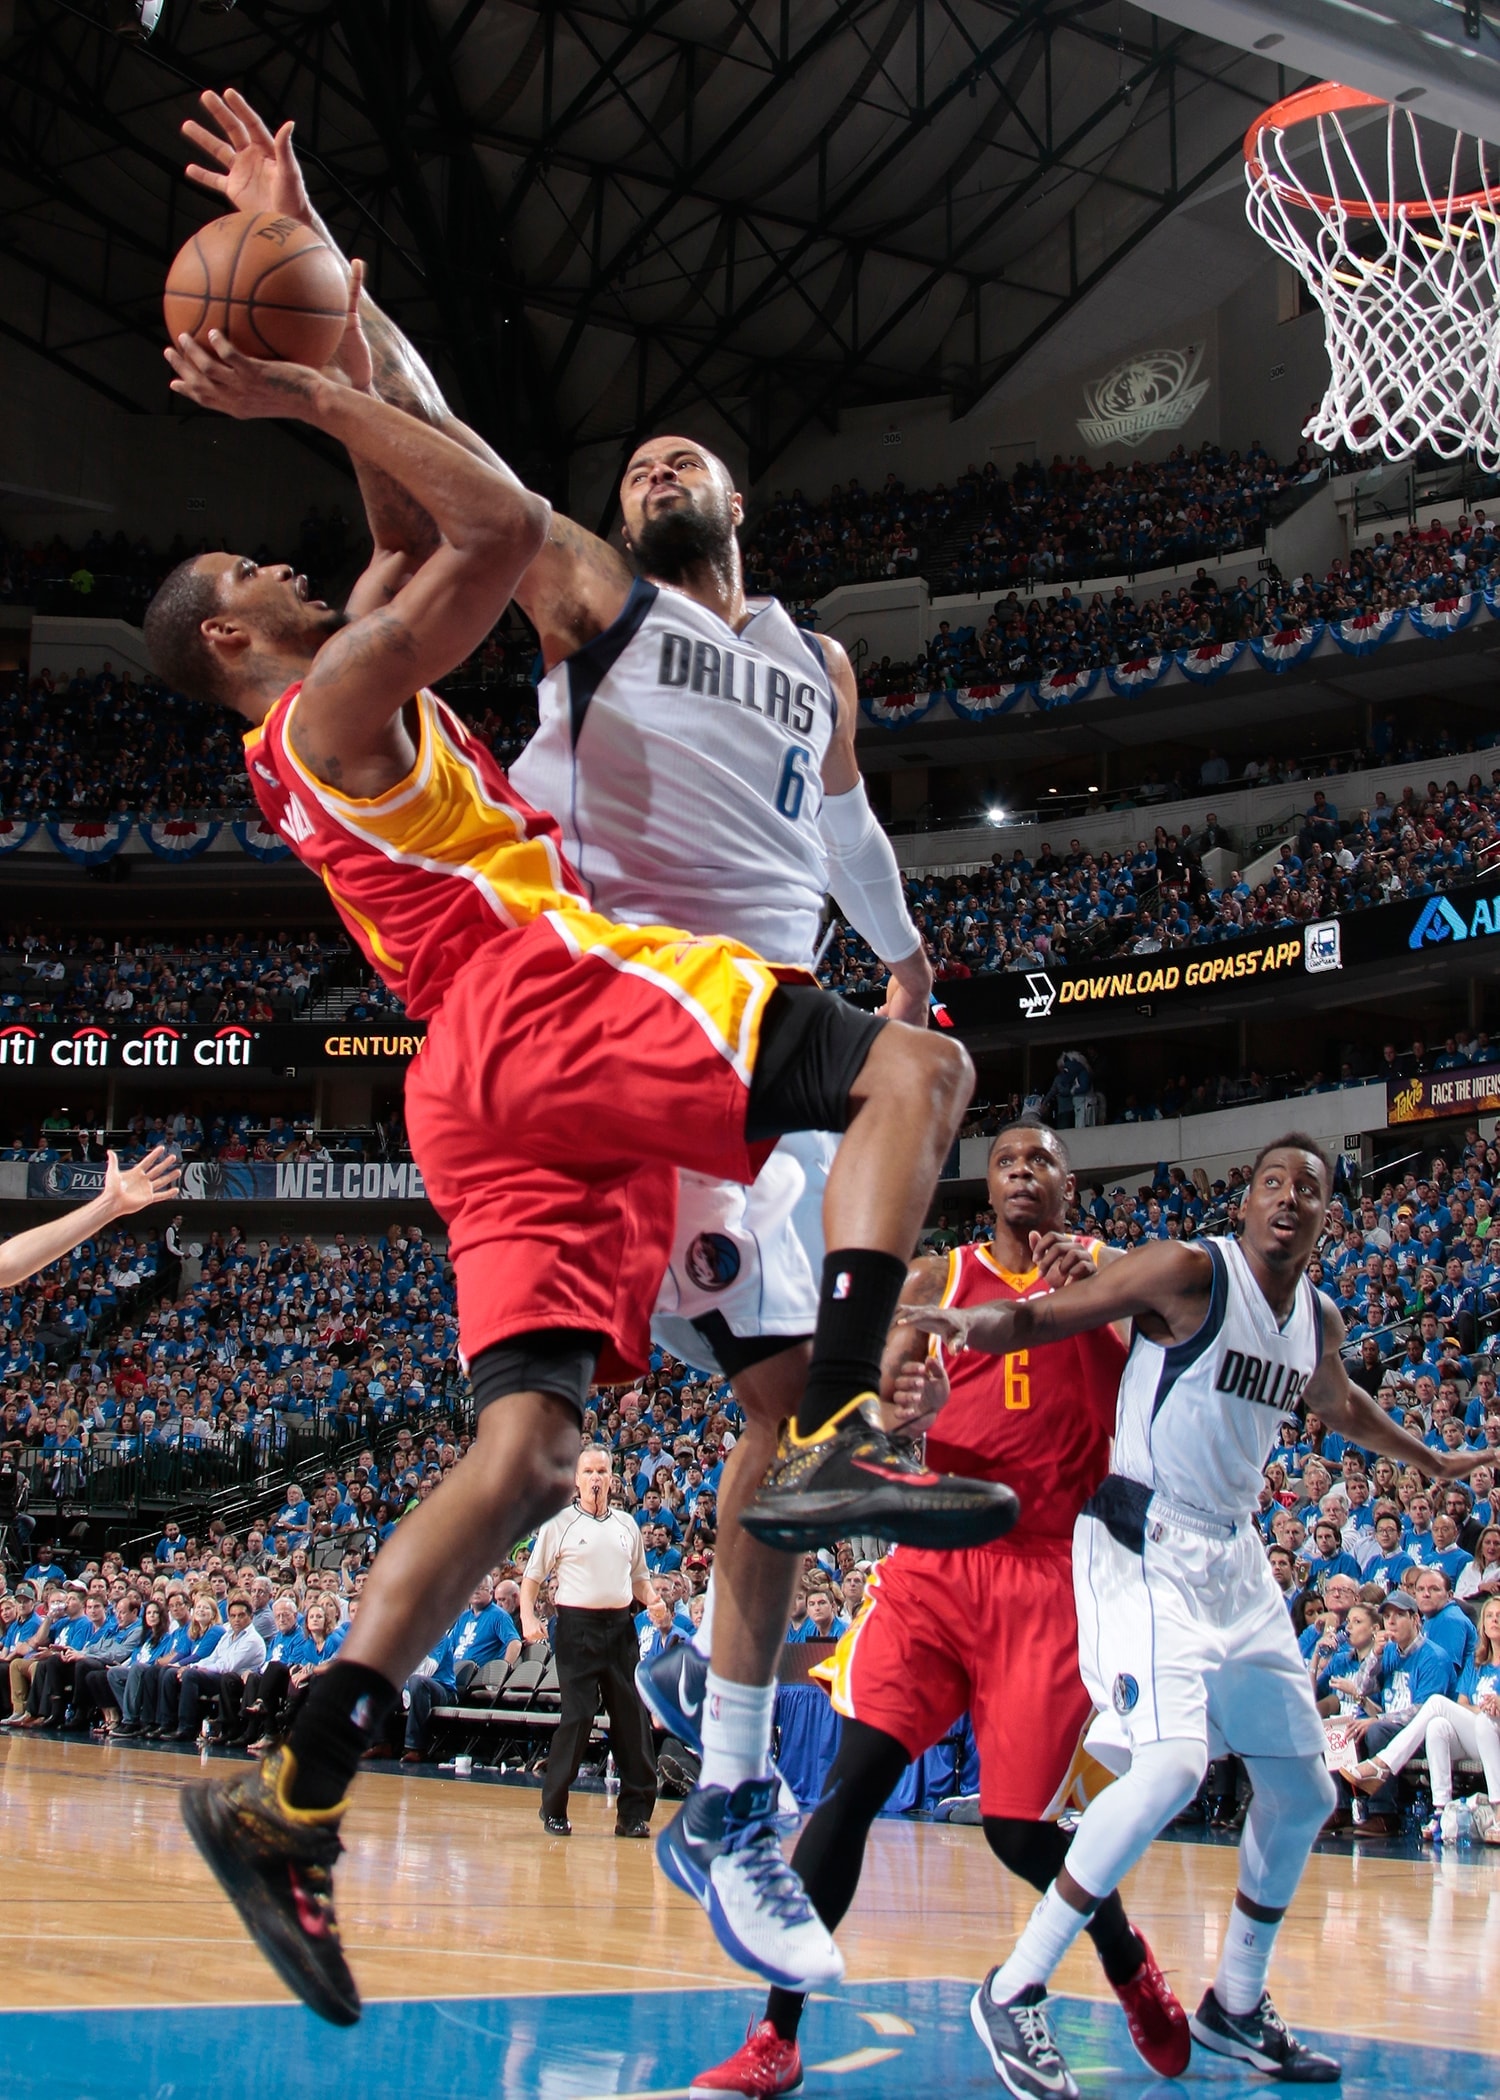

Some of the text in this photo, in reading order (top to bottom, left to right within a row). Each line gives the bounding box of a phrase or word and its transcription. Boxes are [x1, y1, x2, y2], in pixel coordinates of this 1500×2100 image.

[657, 632, 816, 734] DALLAS
[776, 746, 810, 821] 6
[1059, 940, 1301, 1003] DOWNLOAD GOPASS APP
[1019, 994, 1050, 1008] DART
[51, 1034, 108, 1066] citi
[122, 1034, 178, 1066] citi
[193, 1033, 250, 1066] citi
[324, 1036, 427, 1056] CENTURY
[1394, 1078, 1423, 1121] Takis
[1431, 1082, 1454, 1105] FACE
[1454, 1079, 1471, 1101] THE
[1346, 1135, 1358, 1148] EXIT
[275, 1163, 426, 1199] WELCOME
[1004, 1349, 1030, 1410] 6
